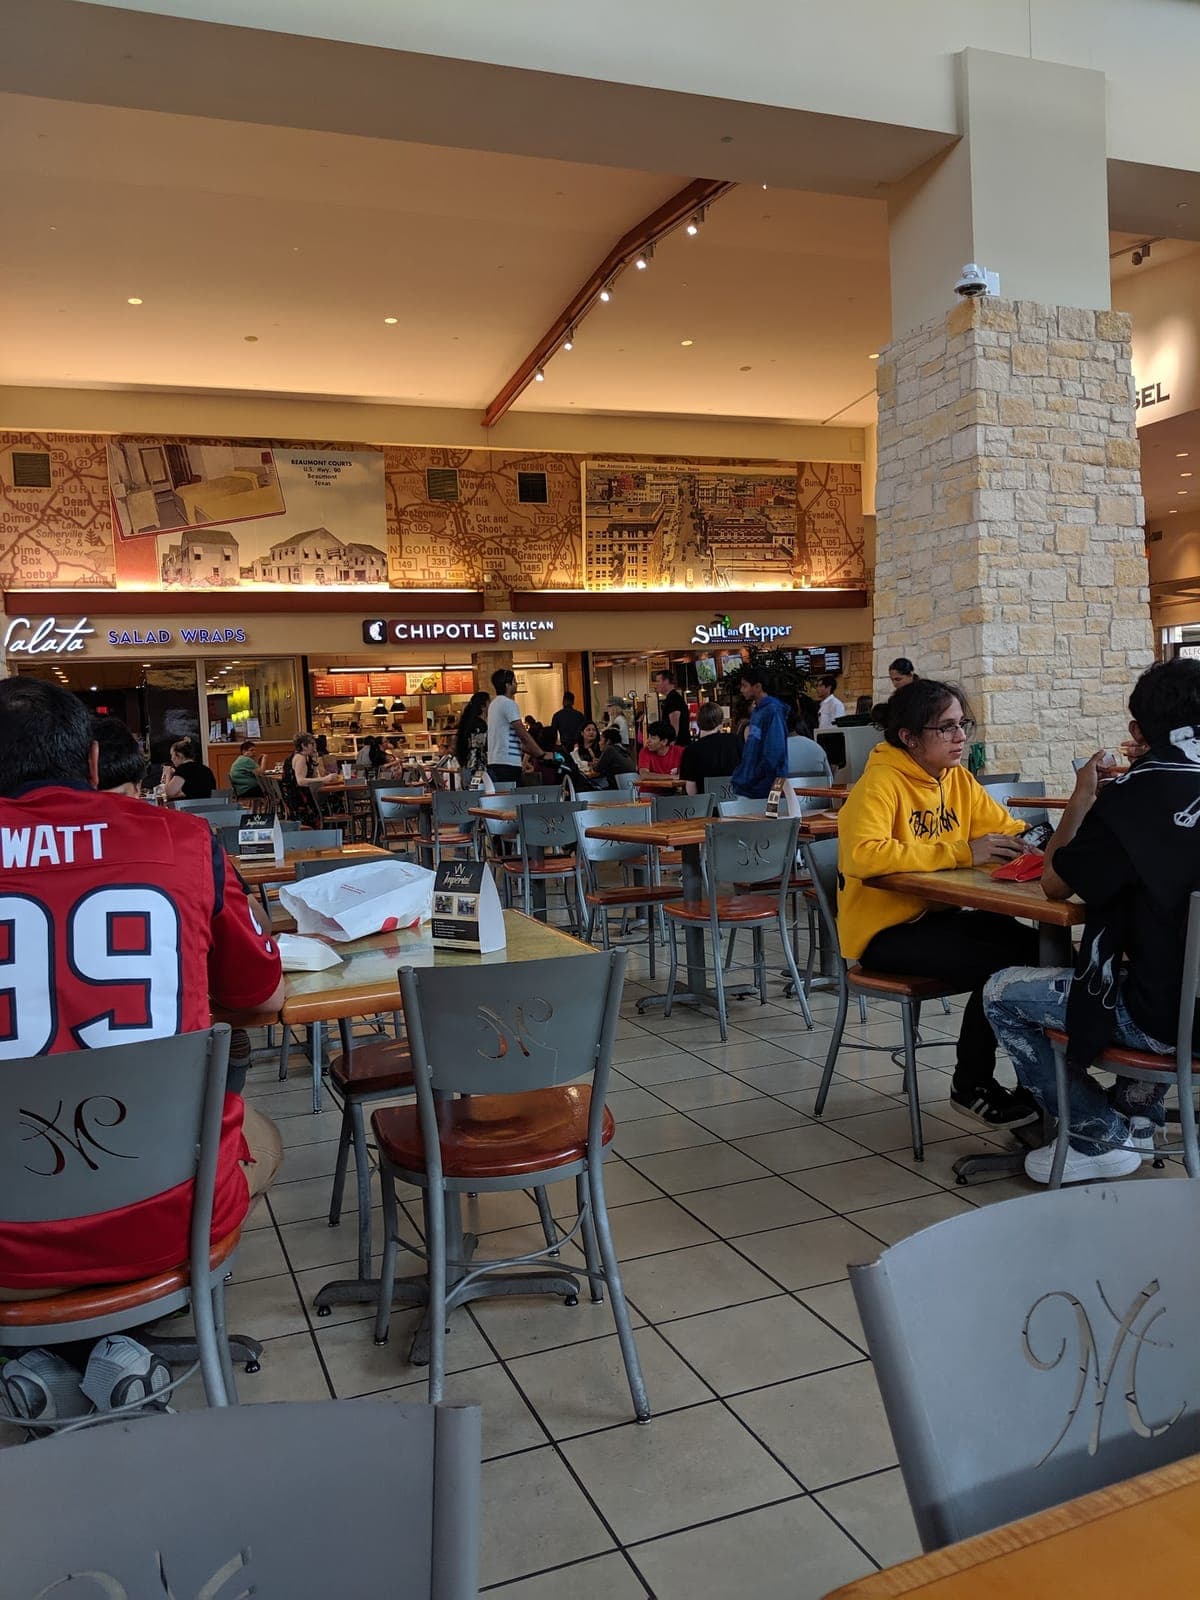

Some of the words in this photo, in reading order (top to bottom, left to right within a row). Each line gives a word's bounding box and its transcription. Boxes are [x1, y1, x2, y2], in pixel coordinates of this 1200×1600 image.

[395, 623, 496, 638] CHIPOTLE
[502, 621, 554, 630] MEXICAN
[4, 617, 95, 653] Salata
[107, 629, 170, 645] SALAD
[181, 628, 246, 643] WRAPS
[503, 632, 536, 641] GRILL
[0, 823, 109, 868] WATT
